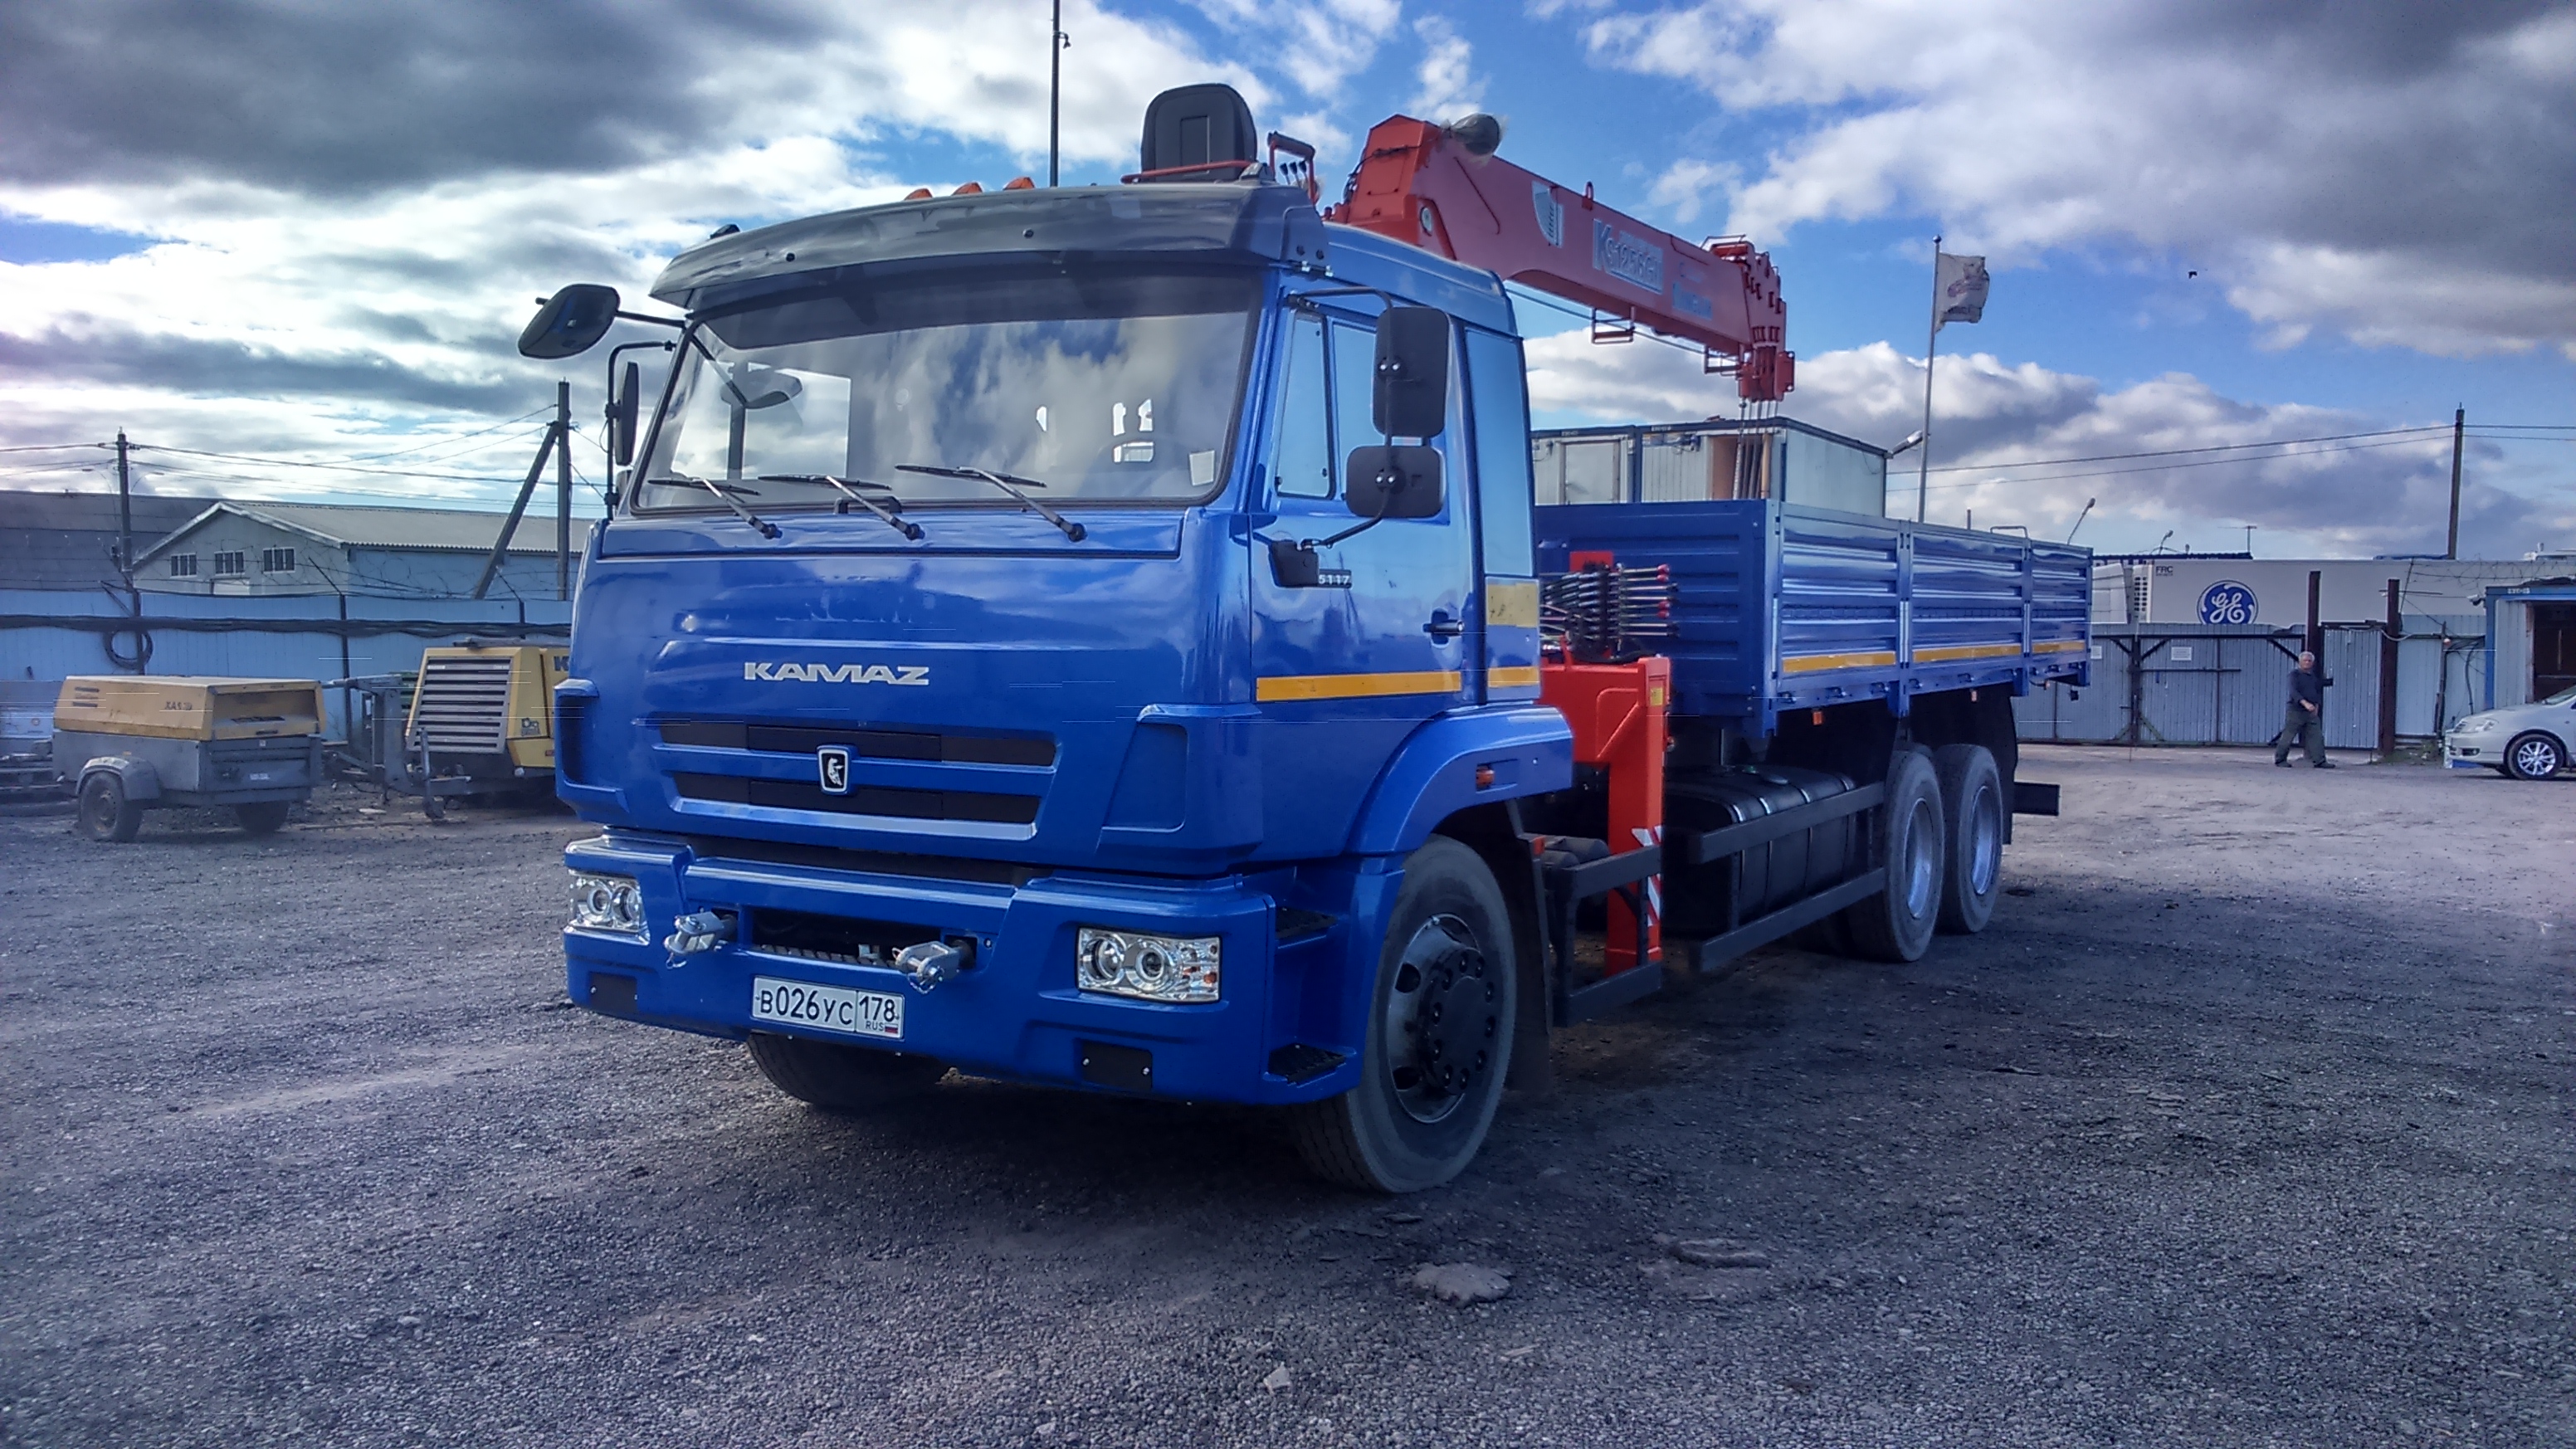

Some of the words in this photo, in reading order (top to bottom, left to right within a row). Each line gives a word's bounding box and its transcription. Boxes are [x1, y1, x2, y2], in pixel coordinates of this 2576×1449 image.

[1319, 574, 1349, 585] 5117
[2209, 593, 2245, 623] GE
[744, 662, 929, 685] KAMAZ
[859, 996, 895, 1022] 178
[865, 1022, 885, 1032] RUS
